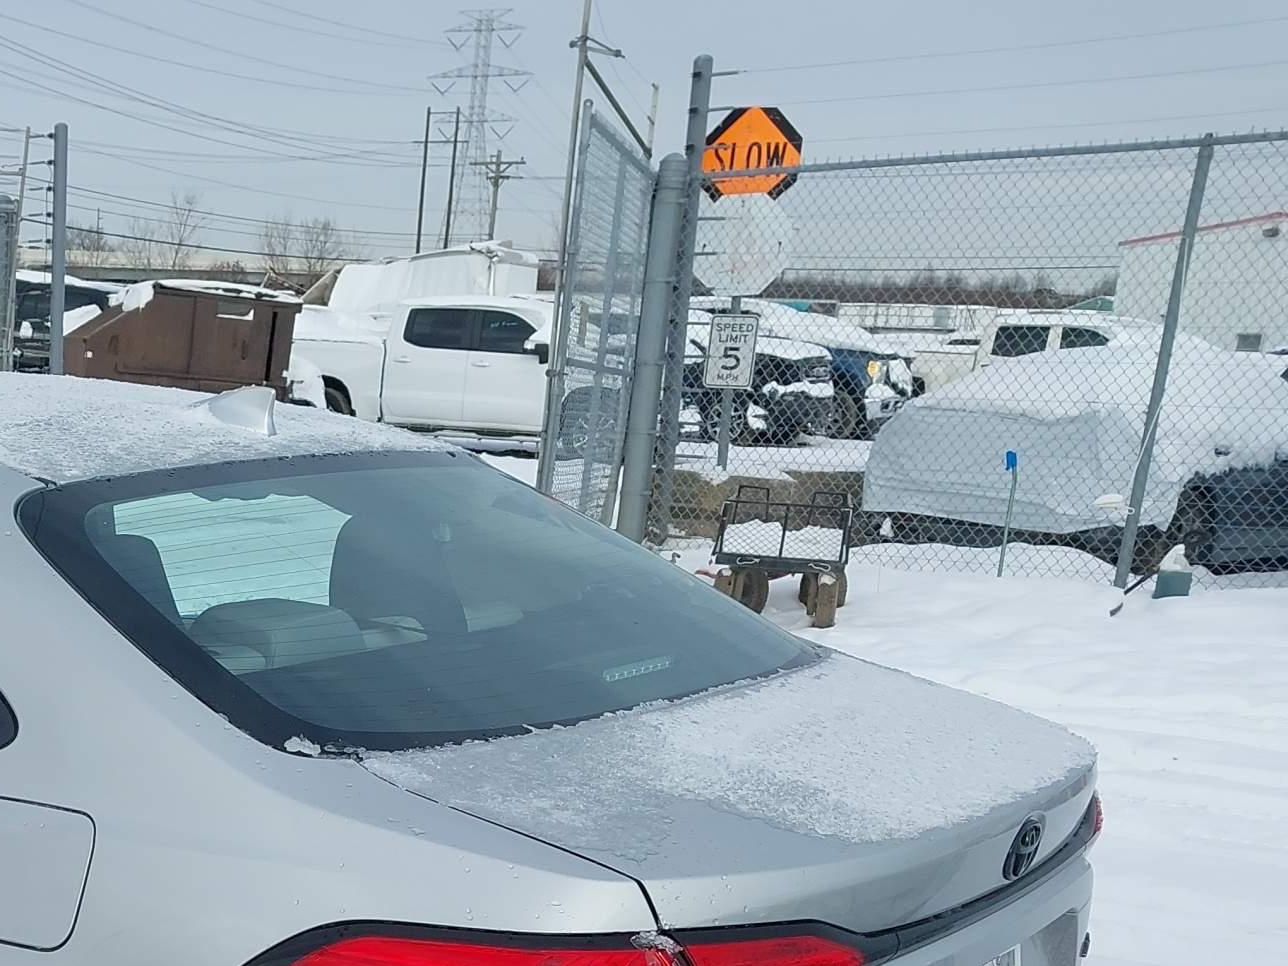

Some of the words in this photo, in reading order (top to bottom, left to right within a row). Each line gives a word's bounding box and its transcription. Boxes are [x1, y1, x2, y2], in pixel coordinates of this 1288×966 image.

[712, 142, 788, 176] SLOW
[716, 322, 754, 333] SPEED
[718, 333, 749, 343] LIMIT
[720, 346, 741, 371] 5
